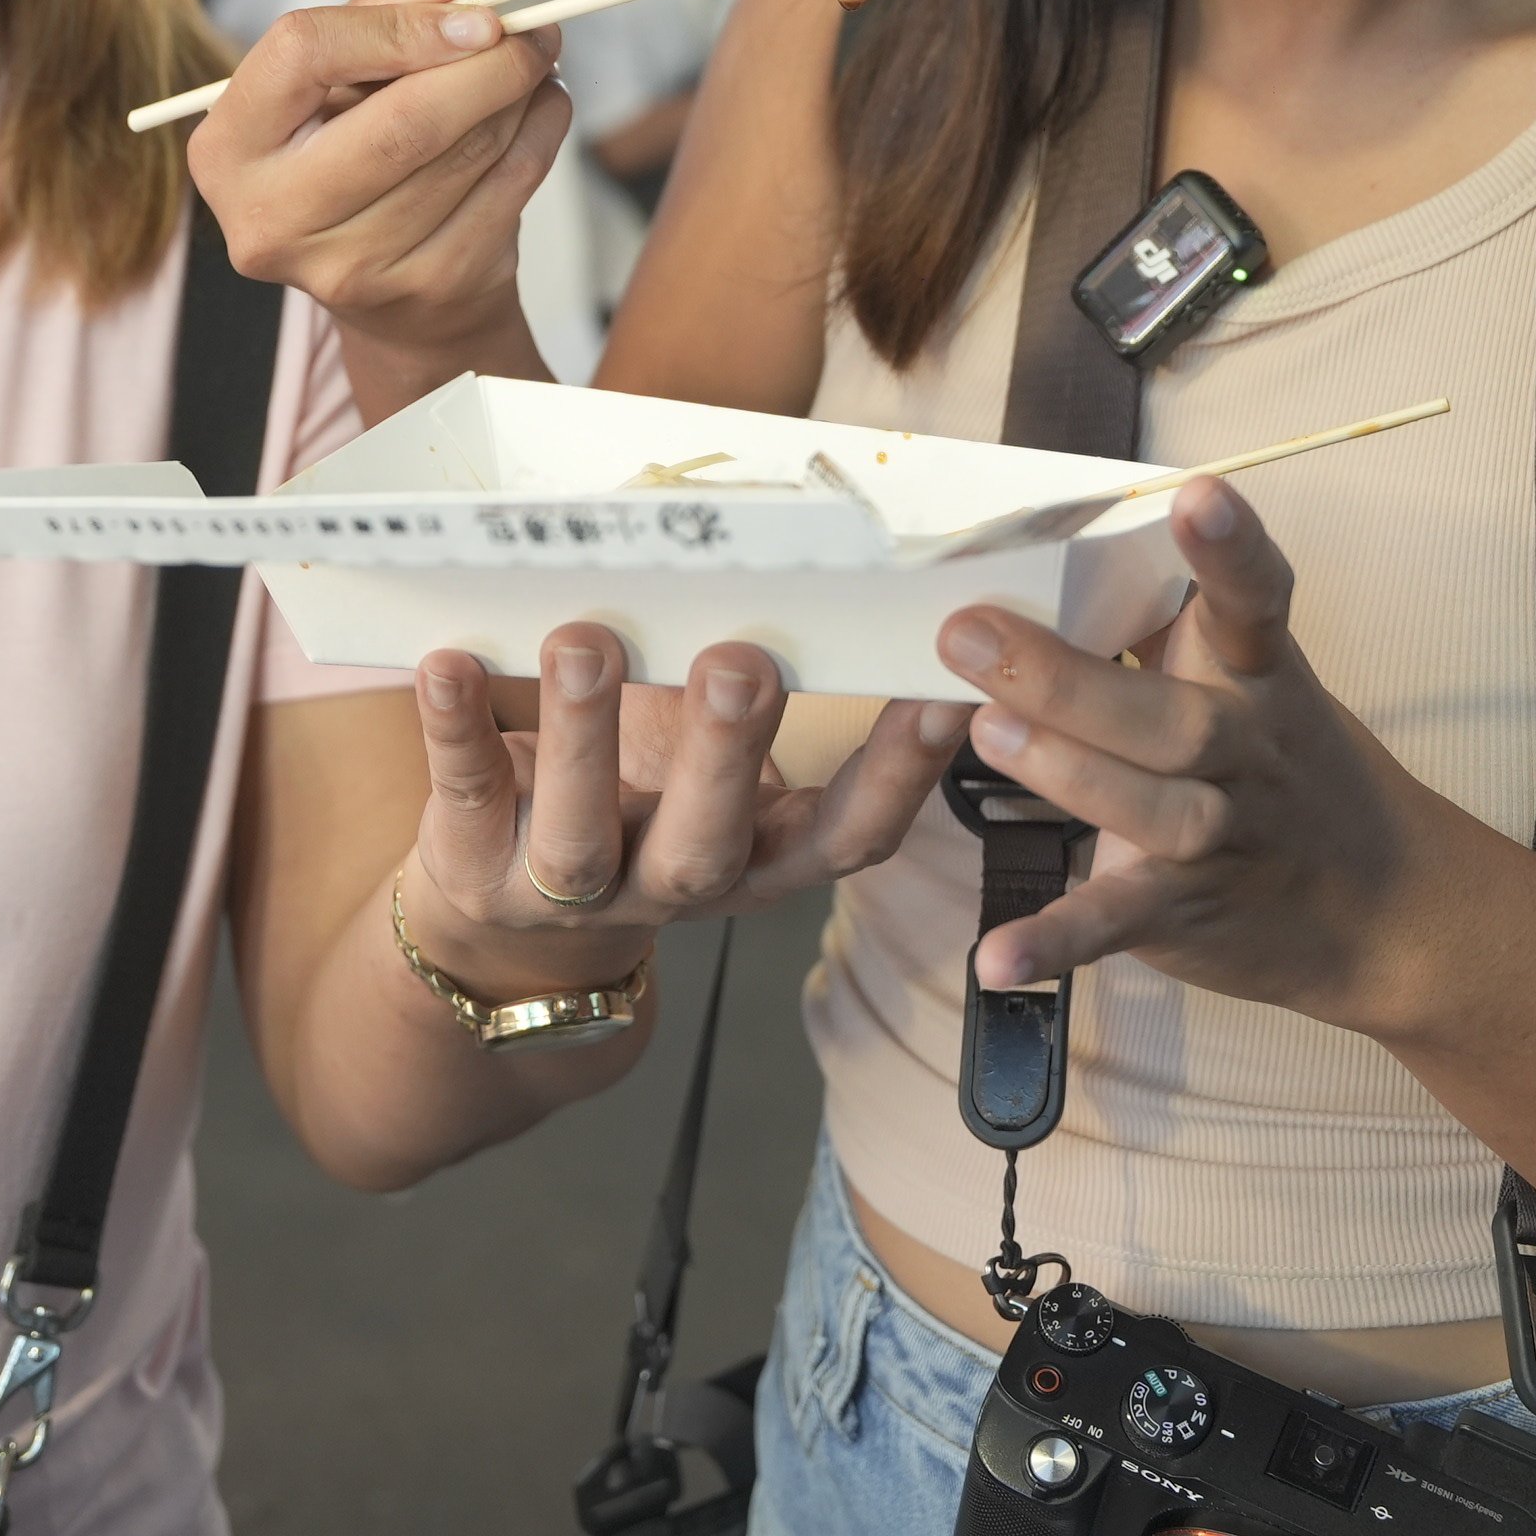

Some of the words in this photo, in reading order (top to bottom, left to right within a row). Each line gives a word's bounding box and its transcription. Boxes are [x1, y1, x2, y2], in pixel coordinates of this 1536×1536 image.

[1164, 1368, 1178, 1380] P
[1181, 1375, 1195, 1388] A
[1146, 1371, 1166, 1395] AUTO
[1133, 1385, 1146, 1399] 3
[1194, 1392, 1207, 1406] S
[1133, 1404, 1145, 1418] 2
[1190, 1409, 1207, 1426] M
[1061, 1414, 1083, 1430] OFF
[1143, 1421, 1155, 1432] 1
[1087, 1424, 1104, 1439] ON
[1161, 1421, 1174, 1444] S&Q
[1121, 1459, 1205, 1502] SONY
[1385, 1464, 1417, 1483] 4K
[1420, 1479, 1454, 1501] INSIDE
[1454, 1495, 1504, 1523] SteadyShot
